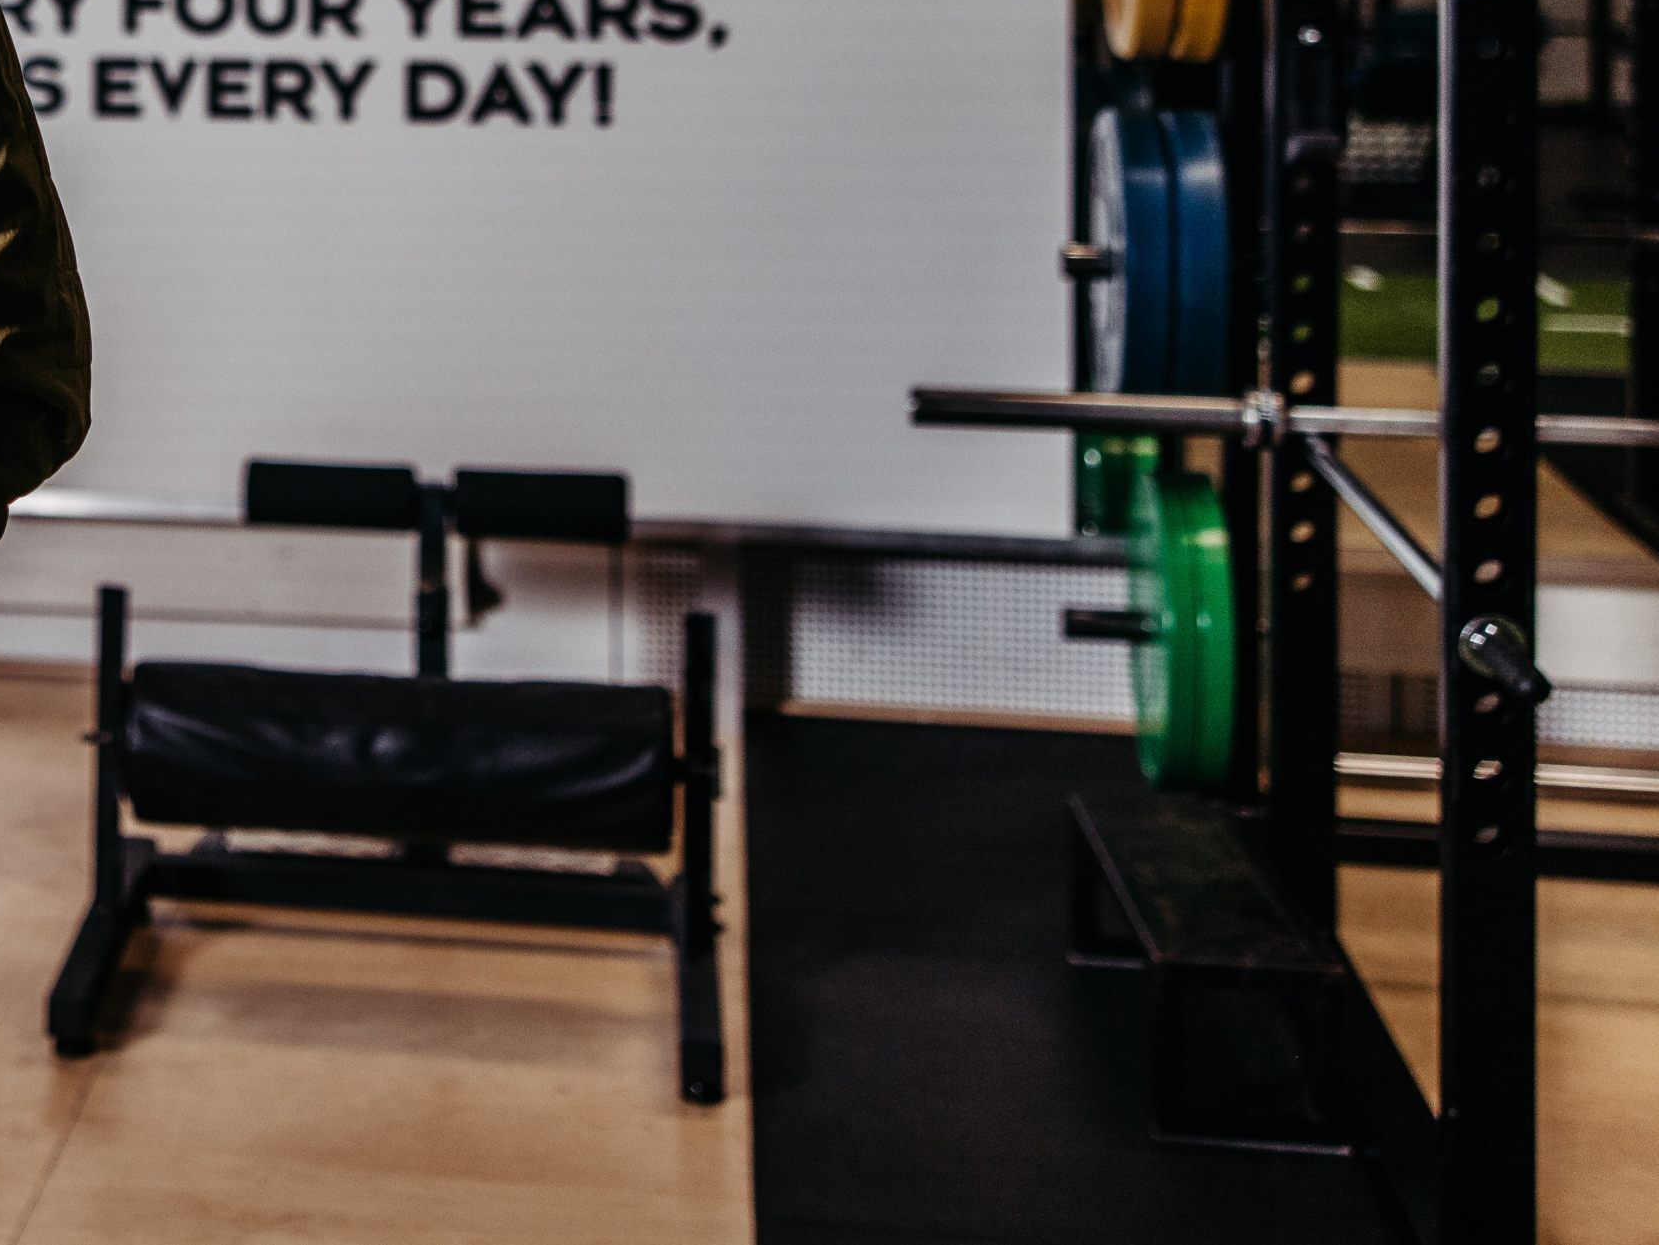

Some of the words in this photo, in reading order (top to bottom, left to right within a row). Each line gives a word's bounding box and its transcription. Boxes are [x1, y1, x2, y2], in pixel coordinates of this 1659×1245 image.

[22, 55, 67, 117] S
[92, 55, 376, 122] EVERY
[403, 58, 615, 127] DAY!
